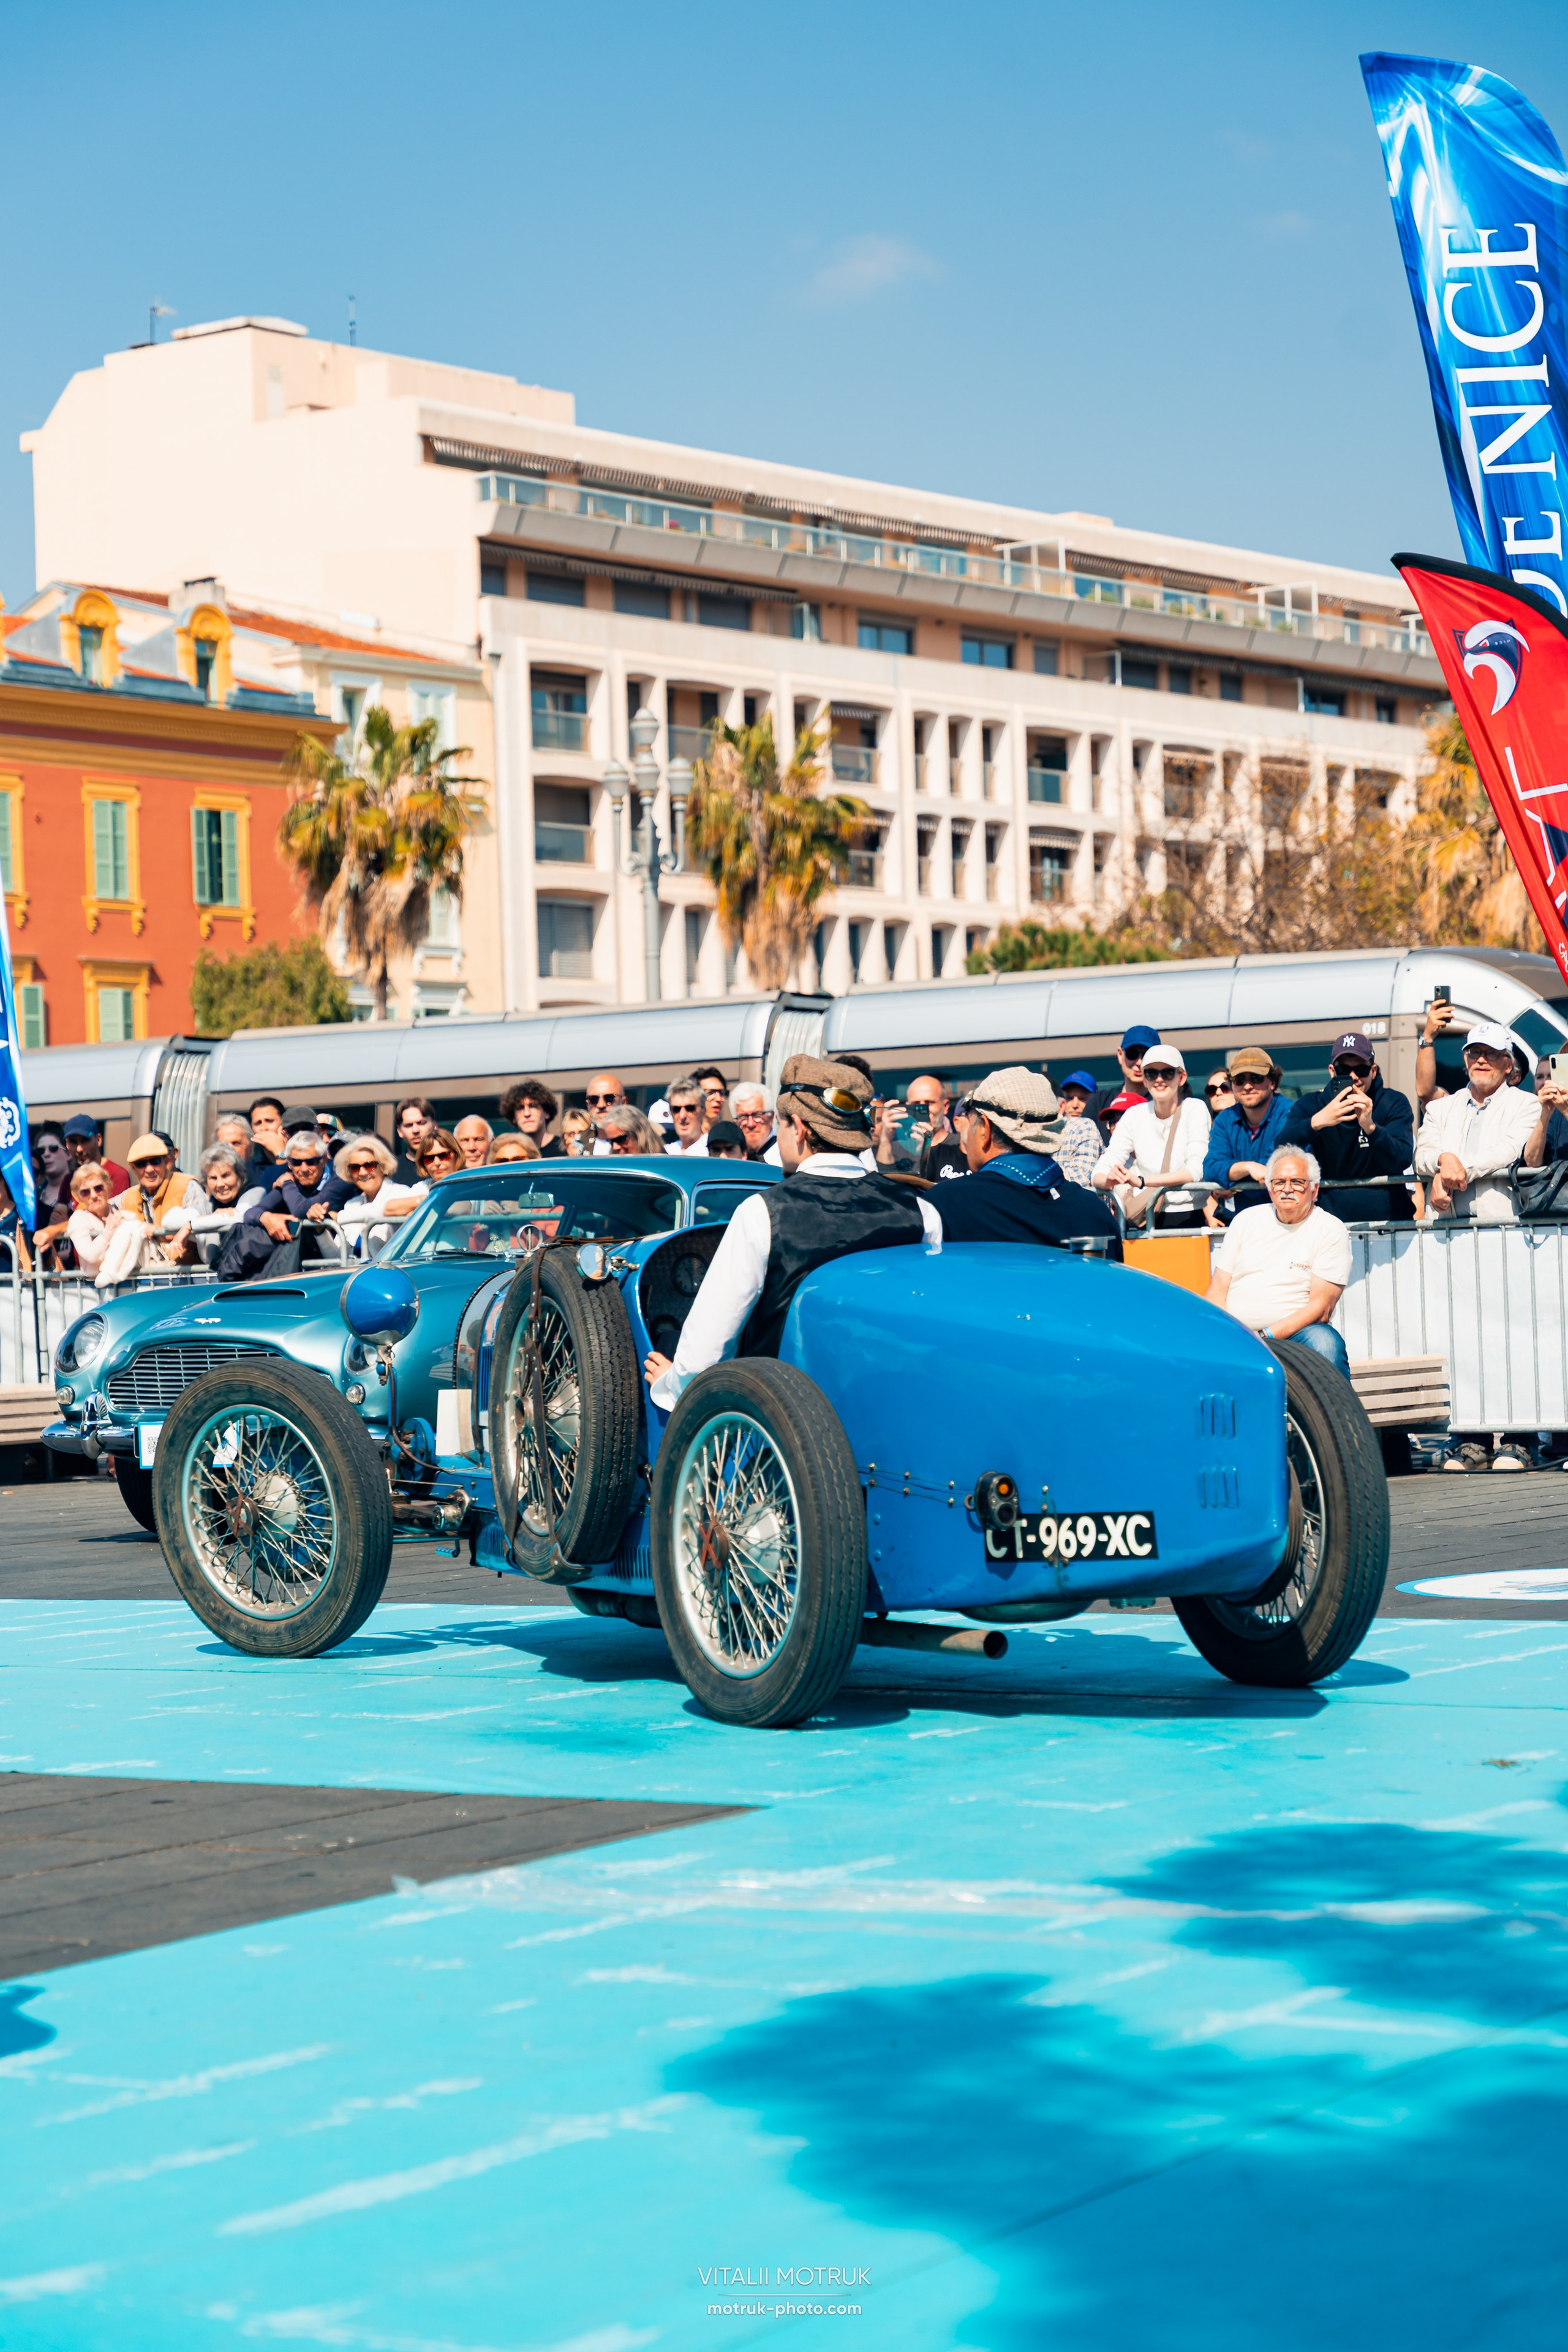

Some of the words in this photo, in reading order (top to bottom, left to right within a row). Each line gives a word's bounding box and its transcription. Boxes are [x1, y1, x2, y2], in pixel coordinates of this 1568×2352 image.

[1438, 222, 1556, 481] NICE
[1342, 1035, 1356, 1047] NY
[986, 1513, 1153, 1559] CT-969-XC
